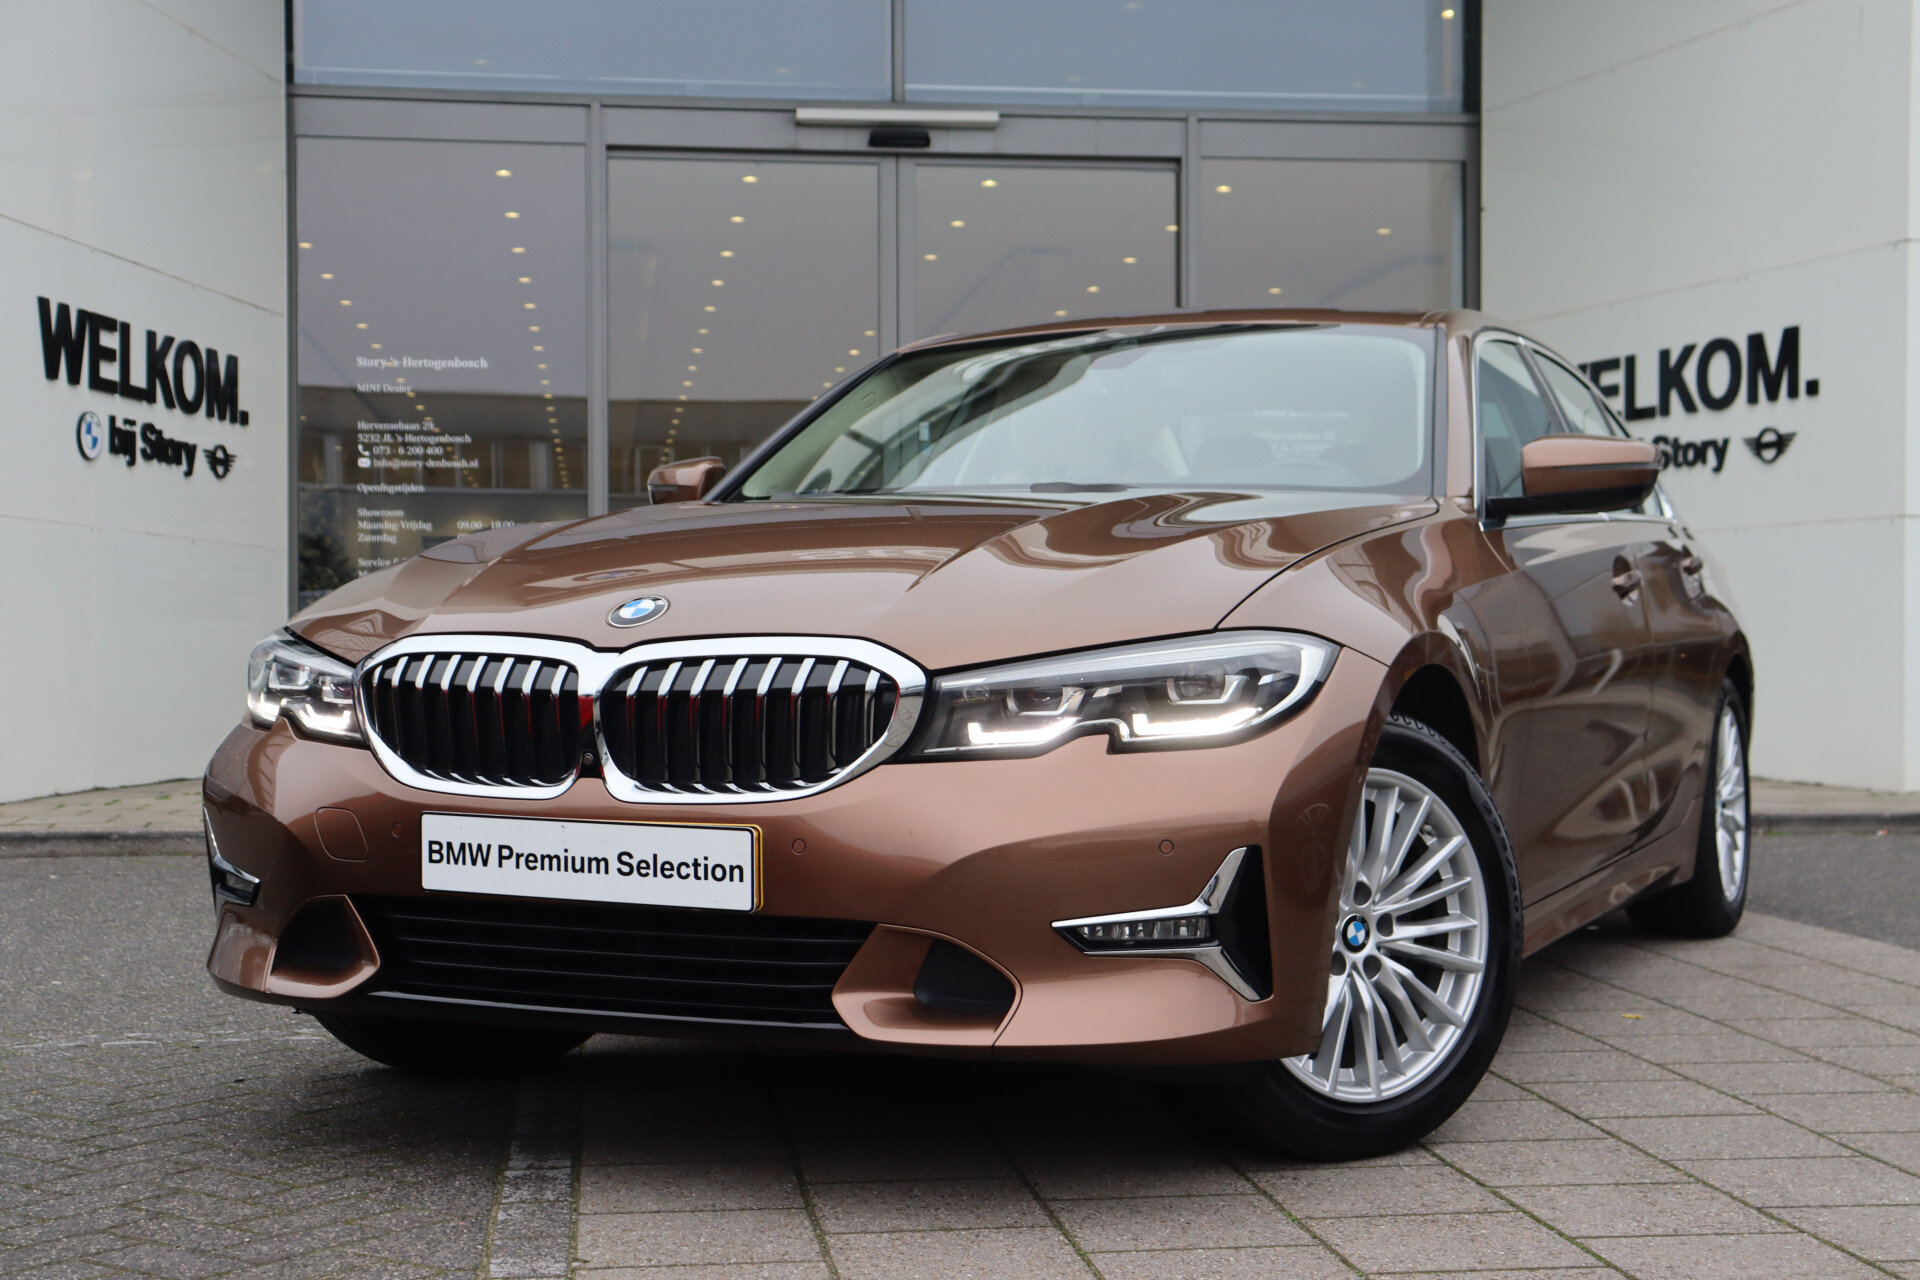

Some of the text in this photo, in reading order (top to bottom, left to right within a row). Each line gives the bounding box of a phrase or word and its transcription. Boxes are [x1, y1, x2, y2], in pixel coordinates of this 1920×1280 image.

[37, 296, 249, 427] WELKOM.
[356, 356, 387, 370] Story
[1578, 324, 1820, 422] ELKOM.
[356, 383, 412, 393] MINI Dealer
[108, 415, 197, 477] bij Story
[357, 483, 425, 495] Openingstijden
[357, 507, 404, 517] Showroom
[357, 532, 397, 544] Zaterdag
[427, 840, 745, 883] BMW Premium Selection
